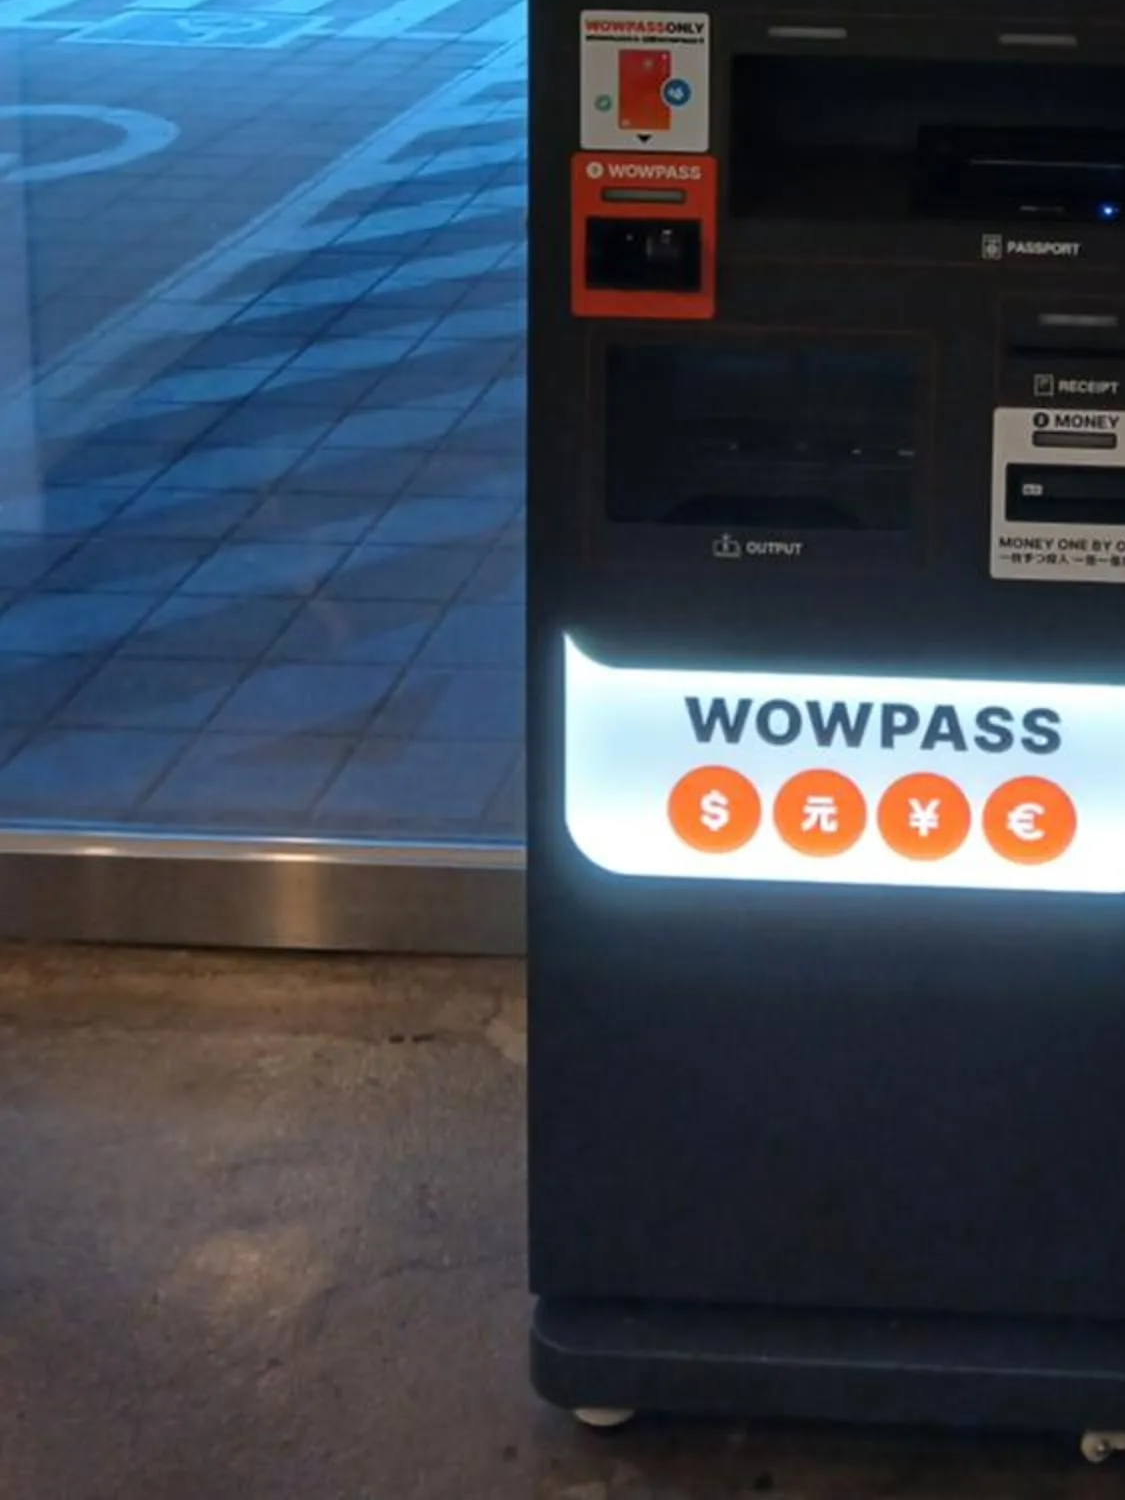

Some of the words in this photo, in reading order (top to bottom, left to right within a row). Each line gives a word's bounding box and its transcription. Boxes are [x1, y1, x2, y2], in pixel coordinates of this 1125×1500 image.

[608, 163, 702, 180] WOWPASS
[1007, 241, 1080, 256] PASSPORT
[1058, 379, 1119, 395] RECEIPT
[1055, 414, 1120, 430] MONEY
[746, 541, 803, 556] OUTPUT
[1000, 536, 1053, 549] MONEY
[1057, 538, 1087, 550] ONE
[1092, 539, 1112, 551] BY
[684, 696, 1063, 756] WOWPASS
